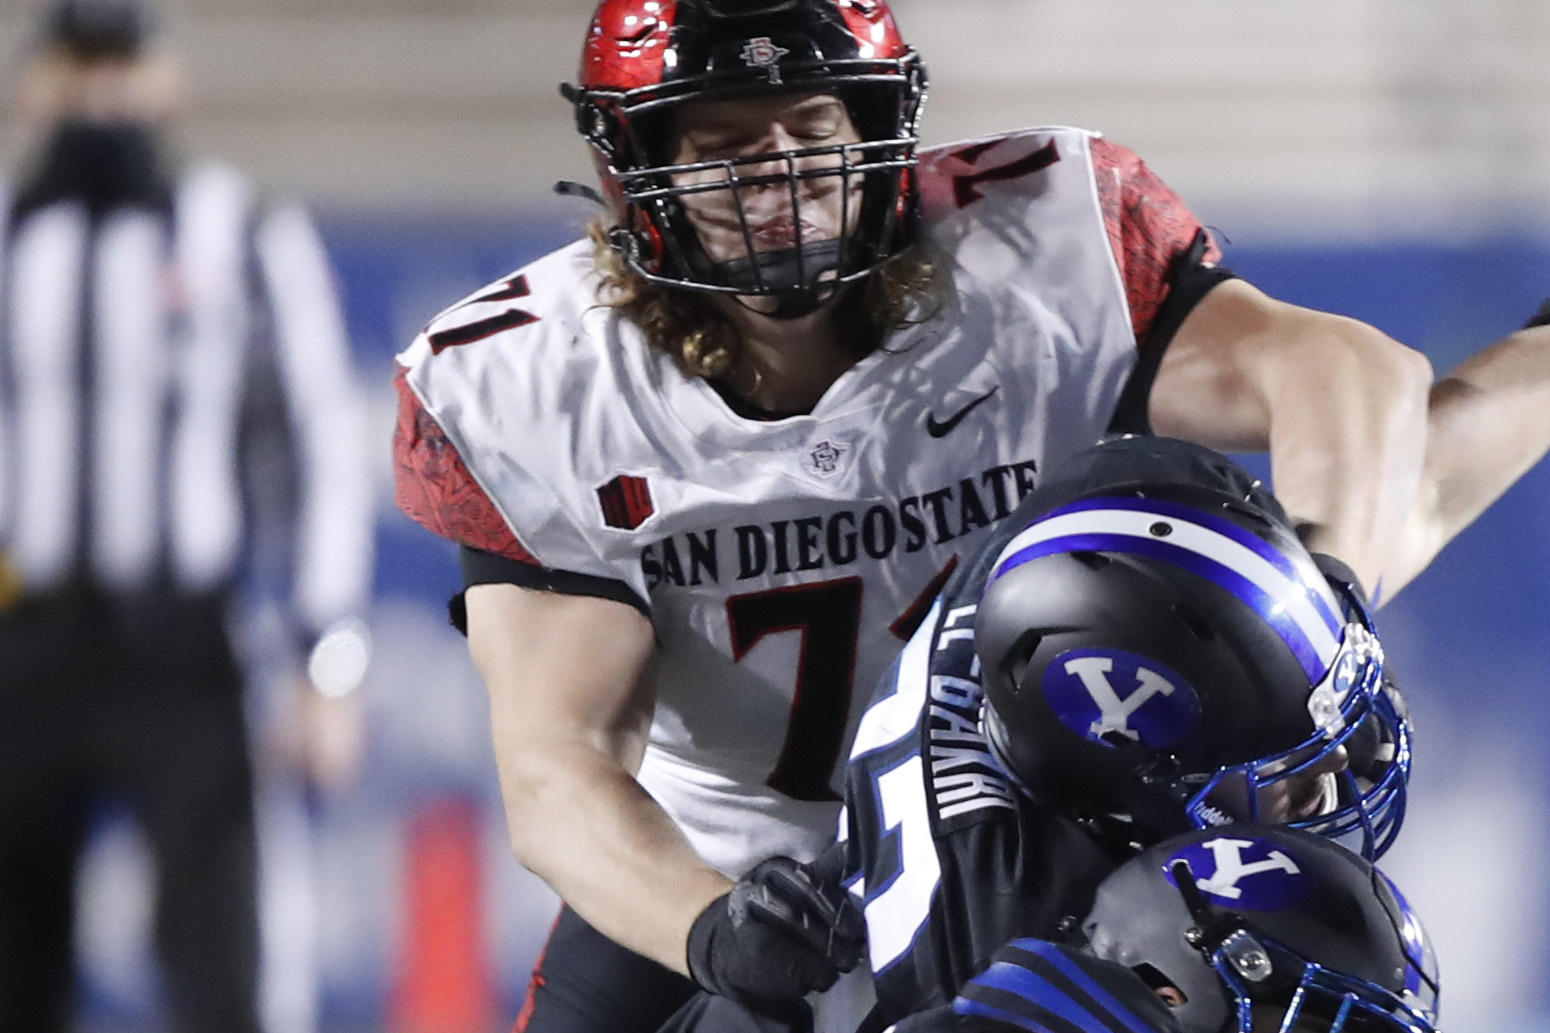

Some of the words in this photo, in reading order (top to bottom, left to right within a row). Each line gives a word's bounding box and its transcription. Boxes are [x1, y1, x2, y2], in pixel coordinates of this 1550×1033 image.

[641, 528, 719, 591] SAN
[734, 505, 897, 581] DIEGO
[899, 460, 1038, 552] STATE
[1064, 657, 1176, 741] Y
[1196, 836, 1300, 900] Y
